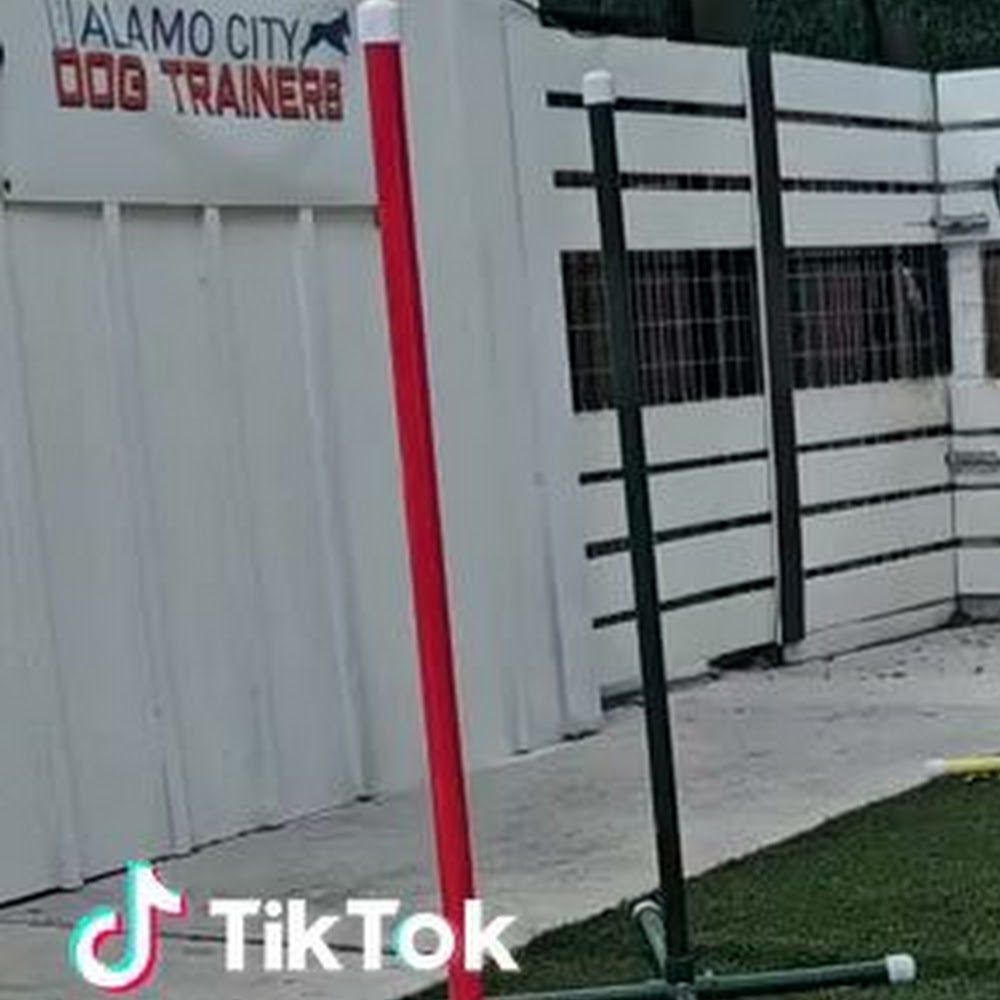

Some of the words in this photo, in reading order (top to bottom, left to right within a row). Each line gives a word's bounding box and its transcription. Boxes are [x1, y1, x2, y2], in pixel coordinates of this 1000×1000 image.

[80, 0, 214, 58] ALAMO
[226, 14, 299, 62] CITY
[54, 50, 147, 111] DOG
